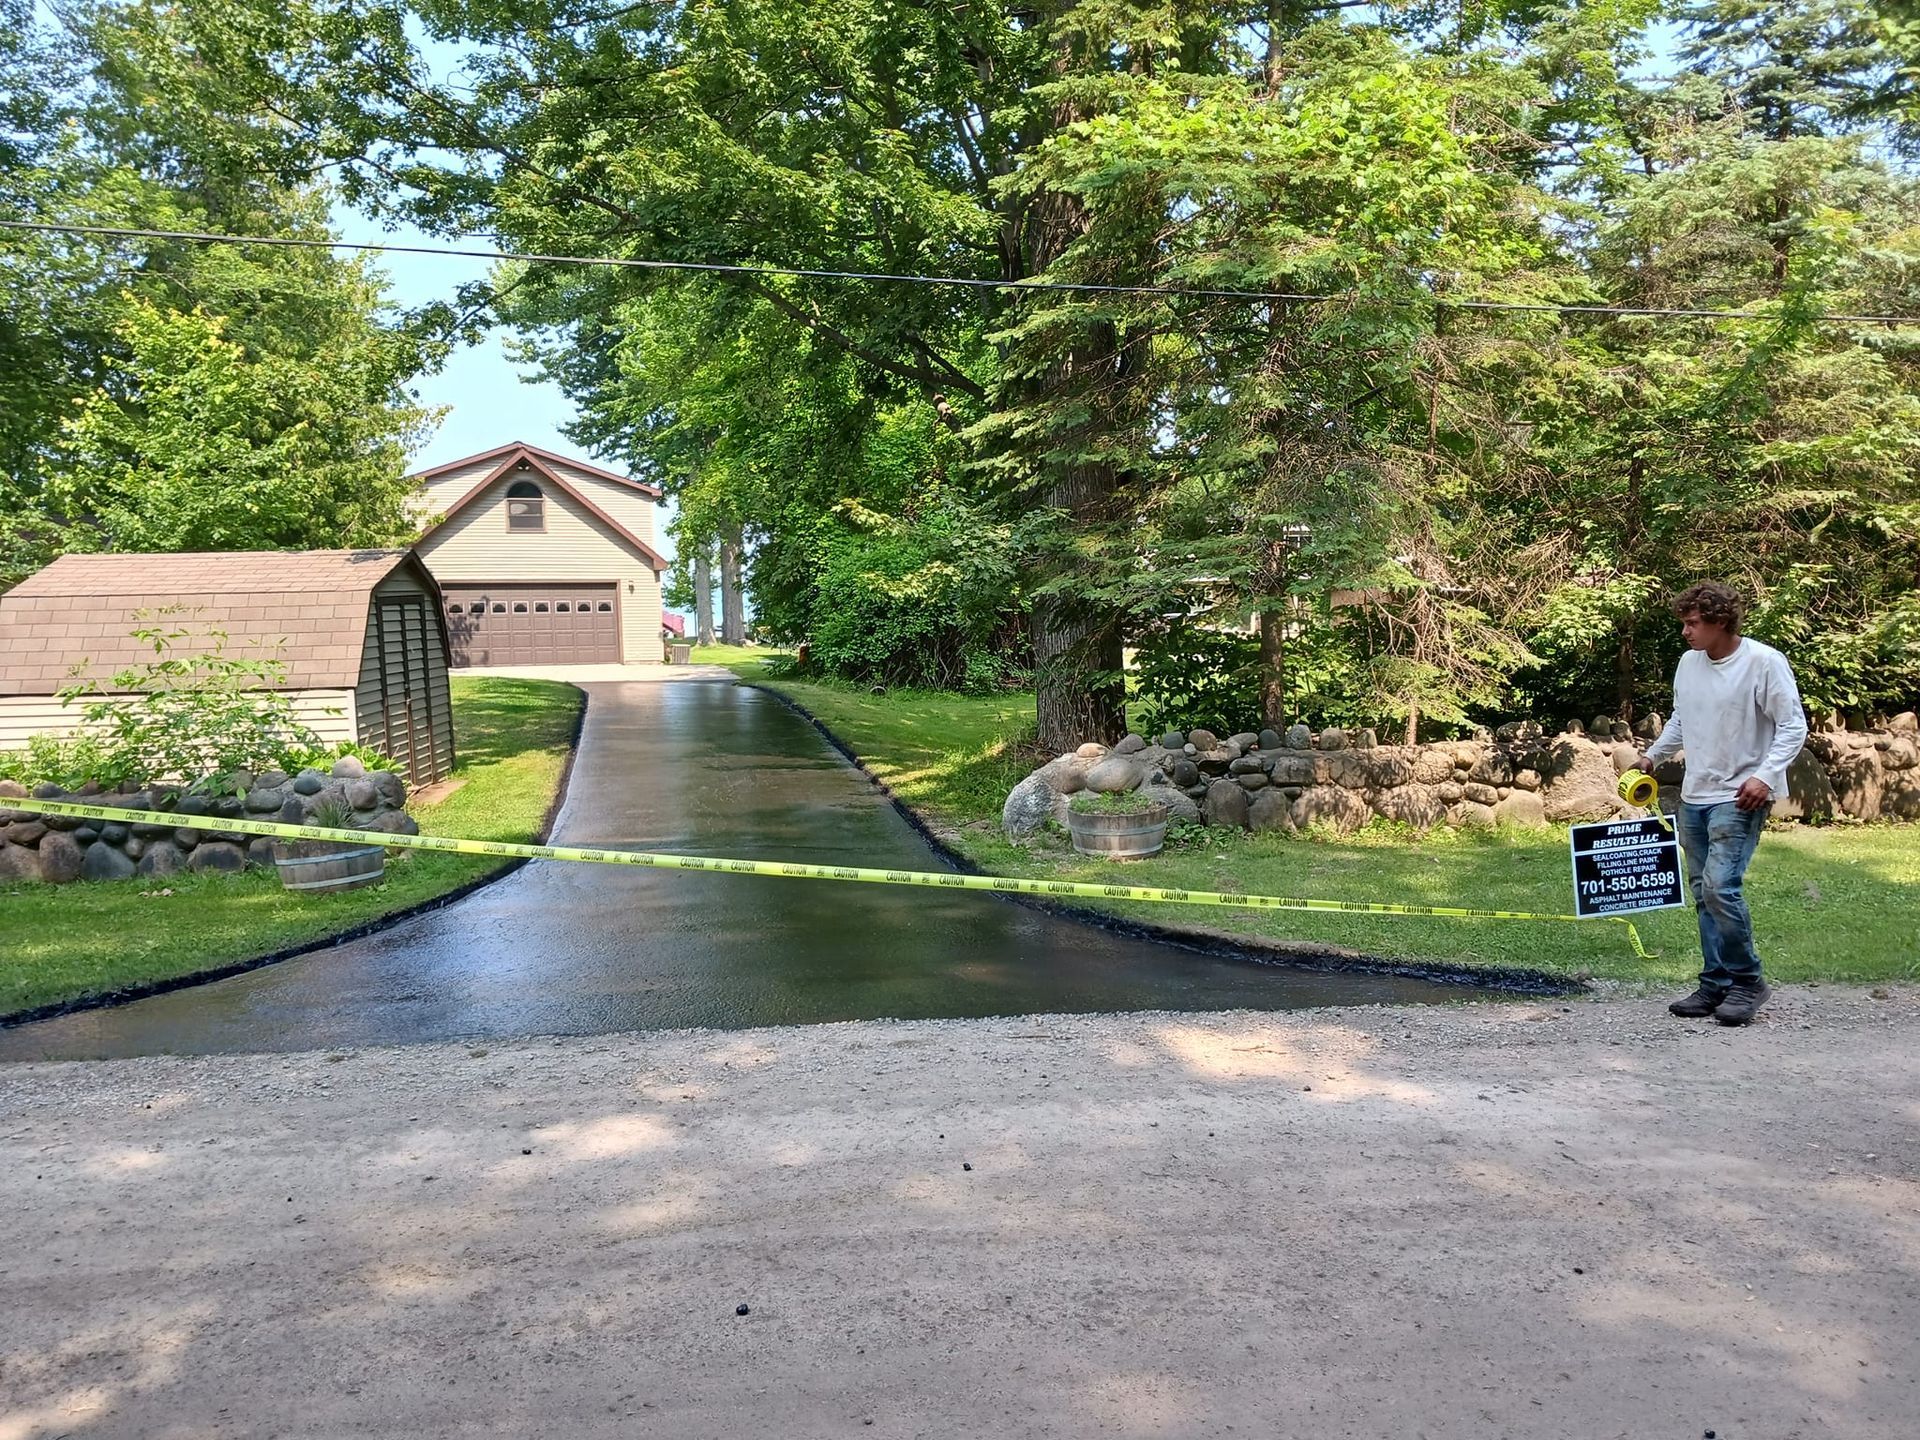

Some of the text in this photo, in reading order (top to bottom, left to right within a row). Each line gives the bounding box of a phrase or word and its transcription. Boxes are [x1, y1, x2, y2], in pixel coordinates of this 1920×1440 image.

[1607, 824, 1642, 835] PRIME
[1592, 834, 1658, 848] RESULTS LLC
[1601, 864, 1656, 876] POTHOLE REPAIR
[1581, 872, 1675, 895] 701-550-6598
[1590, 888, 1672, 904] ASPHALT MAINTENANCE
[1599, 898, 1664, 912] CONCRETE REPAIR
